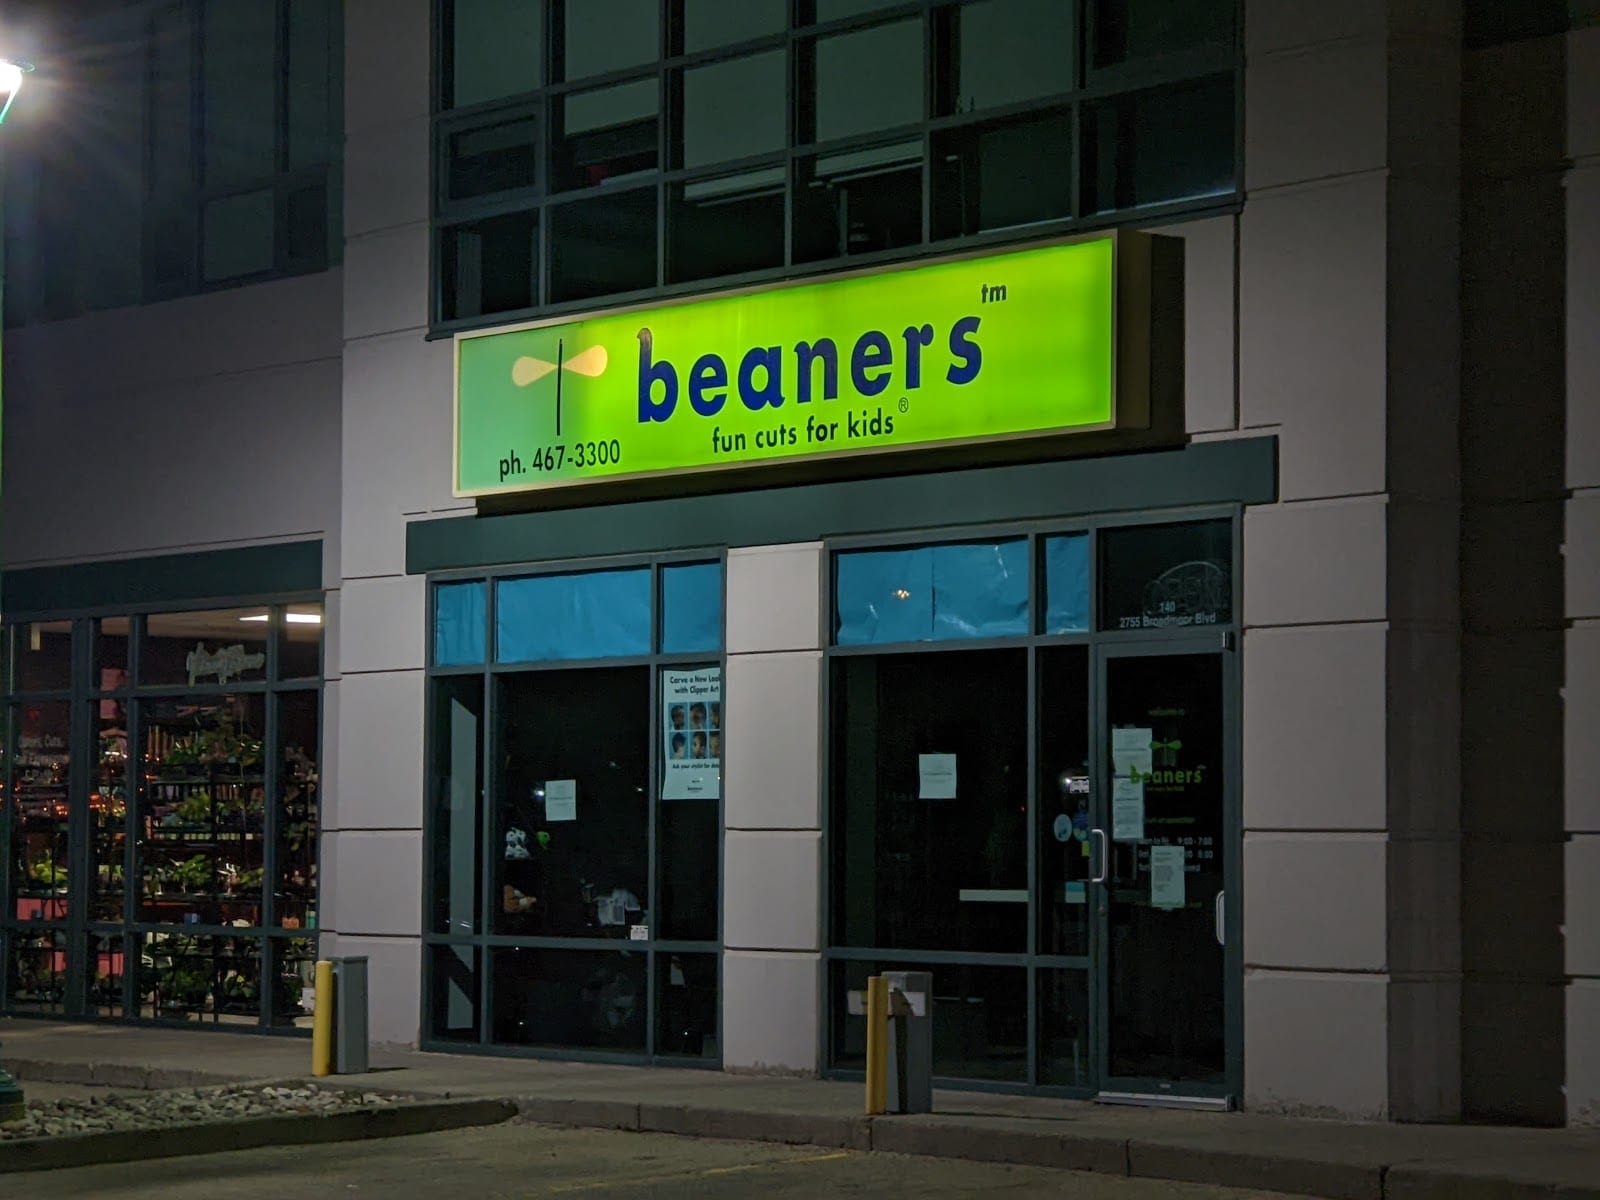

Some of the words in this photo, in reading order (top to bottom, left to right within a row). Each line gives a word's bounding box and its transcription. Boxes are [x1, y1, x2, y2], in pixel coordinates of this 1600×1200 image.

[981, 284, 1007, 303] tm
[636, 316, 983, 424] beaners
[712, 426, 747, 454] fun
[755, 424, 797, 449] cuts
[806, 415, 839, 443] for
[847, 407, 894, 438] kids
[499, 449, 527, 482] ph.
[532, 439, 620, 471] 467-3300
[1160, 601, 1176, 613] 140
[1119, 616, 1141, 629] 2755
[1195, 611, 1217, 624] Blvd
[690, 685, 709, 695] Clipper
[1130, 764, 1203, 785] beaners
